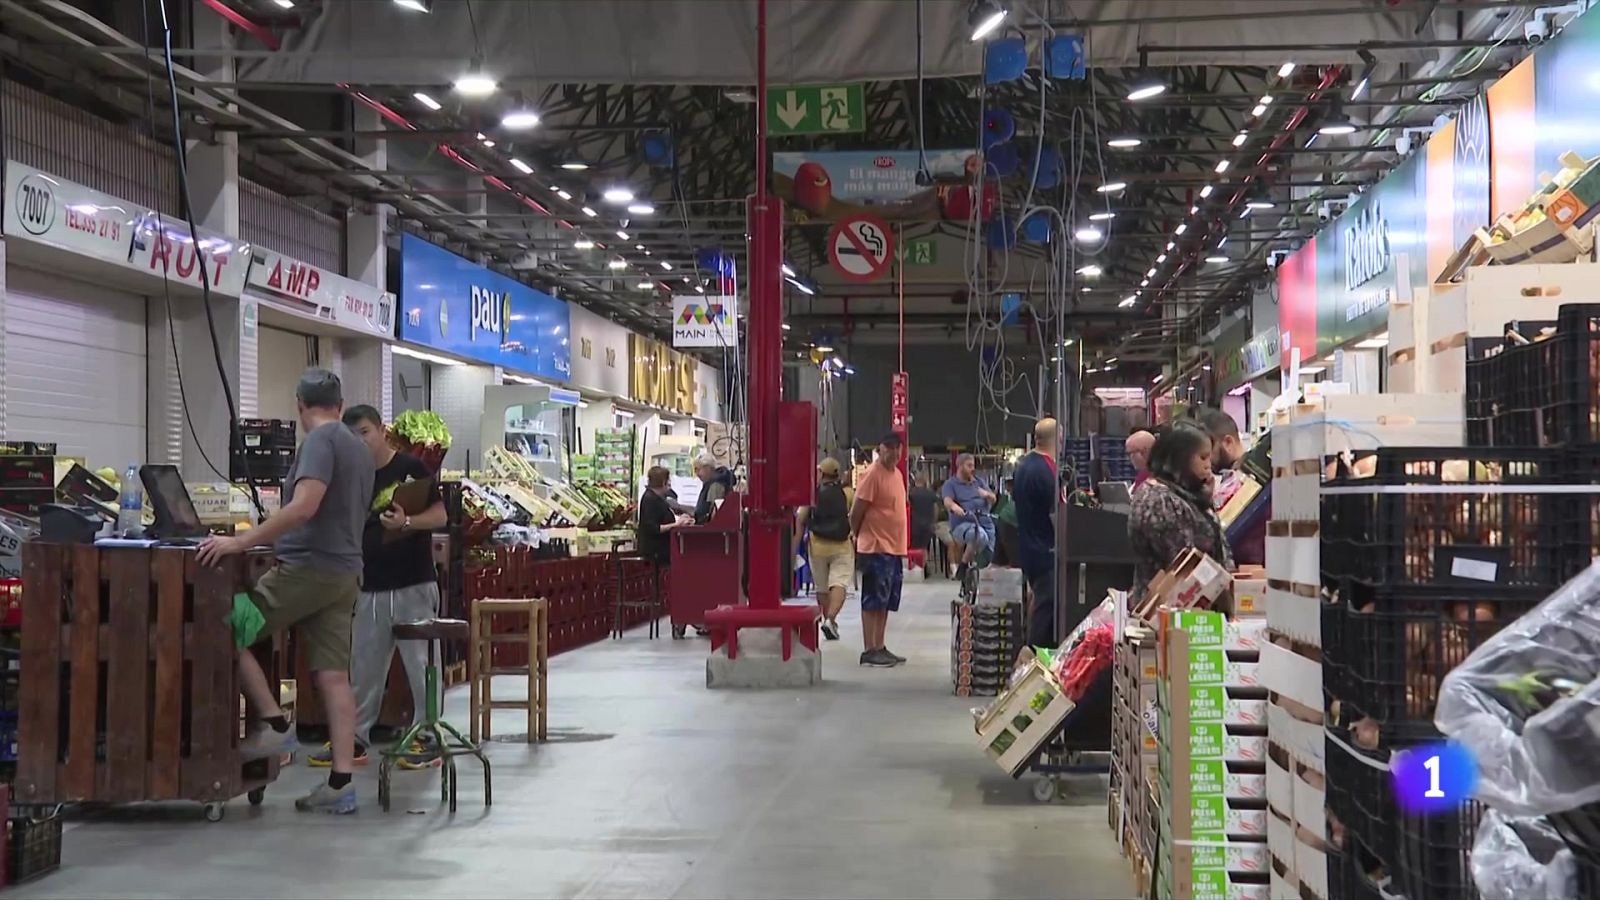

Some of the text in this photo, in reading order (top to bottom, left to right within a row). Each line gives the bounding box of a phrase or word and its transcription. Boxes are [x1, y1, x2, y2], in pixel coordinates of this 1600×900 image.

[850, 168, 916, 182] El mango
[23, 184, 49, 226] 7007
[472, 285, 500, 342] pau
[675, 330, 706, 338] MAIN
[1189, 625, 1215, 634] FRESH
[1190, 662, 1215, 671] FRESH
[1190, 699, 1216, 707] FRESH
[1190, 736, 1215, 744] FRESH
[1190, 773, 1216, 781] FRESH
[1191, 809, 1216, 817] FRESH
[1192, 883, 1218, 891] FRESH
